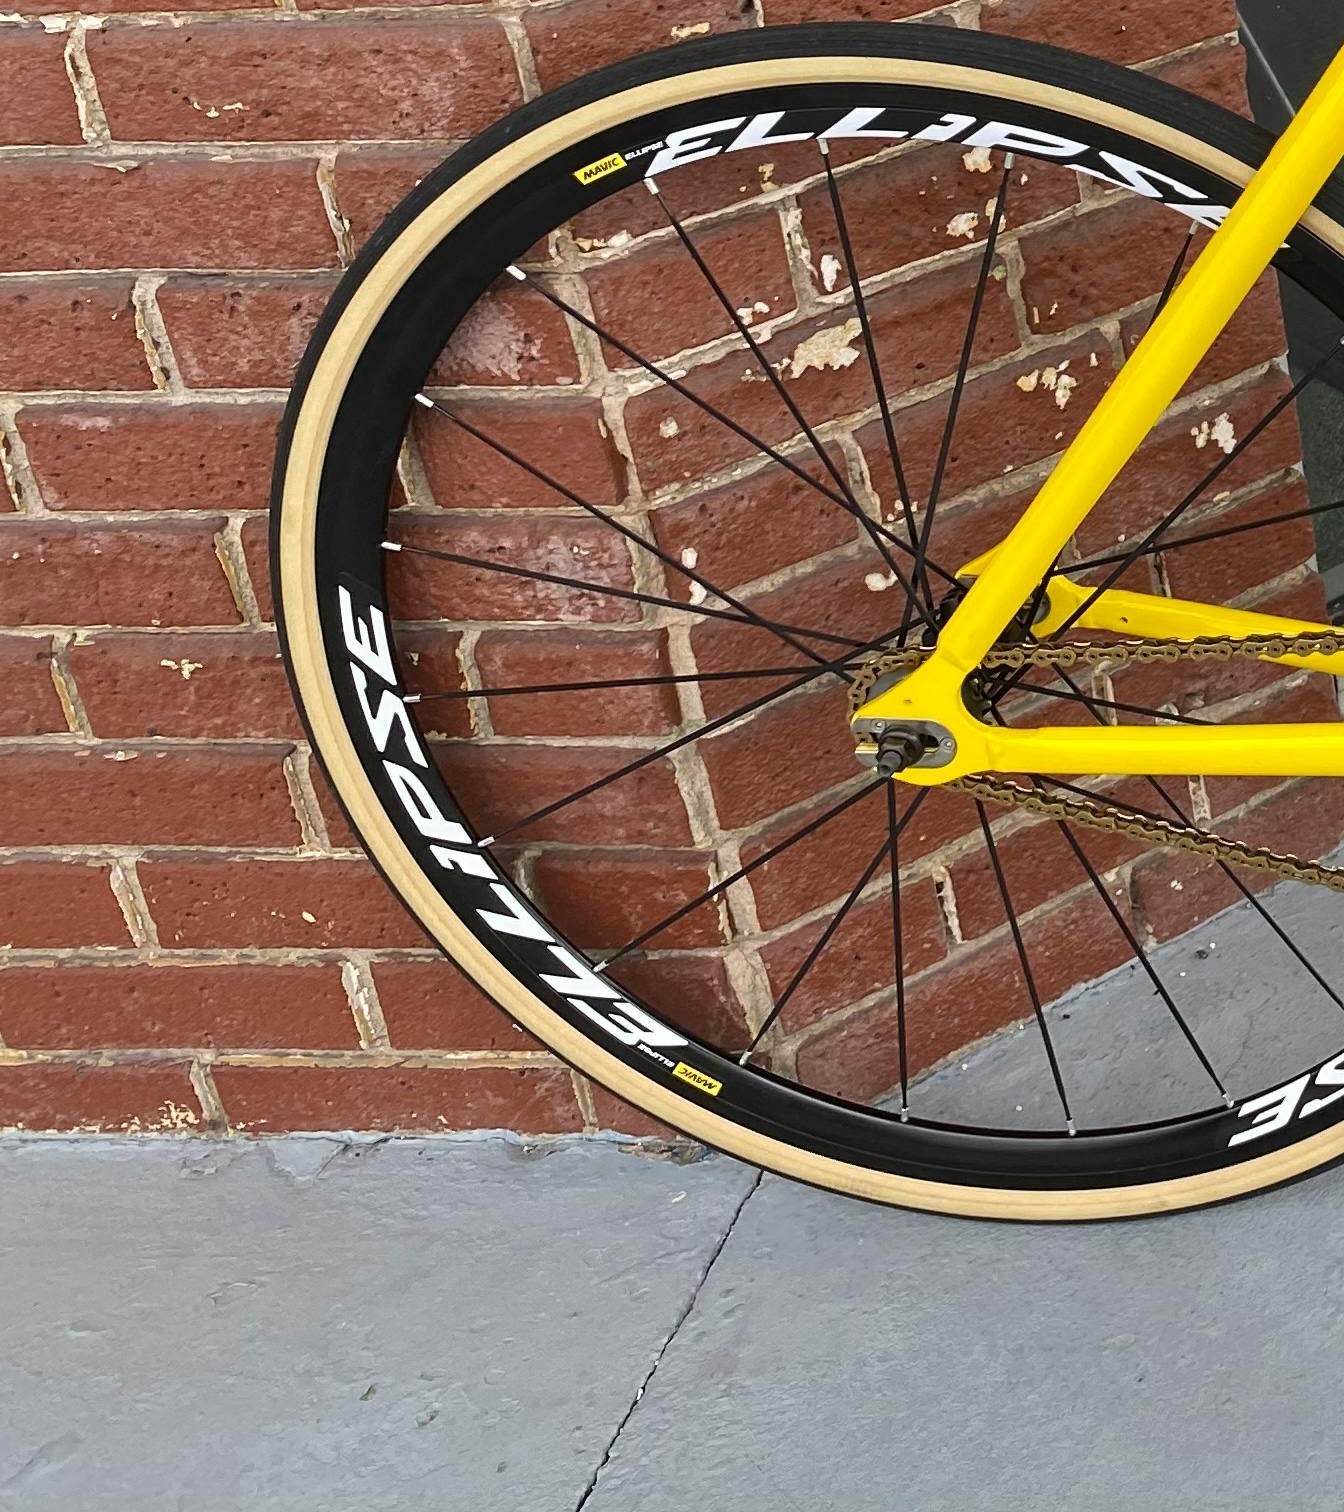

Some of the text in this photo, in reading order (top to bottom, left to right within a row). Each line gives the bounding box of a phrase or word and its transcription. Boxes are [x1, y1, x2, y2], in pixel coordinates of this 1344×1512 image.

[582, 157, 620, 182] MAVIC
[624, 140, 664, 161] ELLIPSE
[337, 584, 689, 1048] ELLIPSE
[676, 1066, 718, 1092] MAVIC
